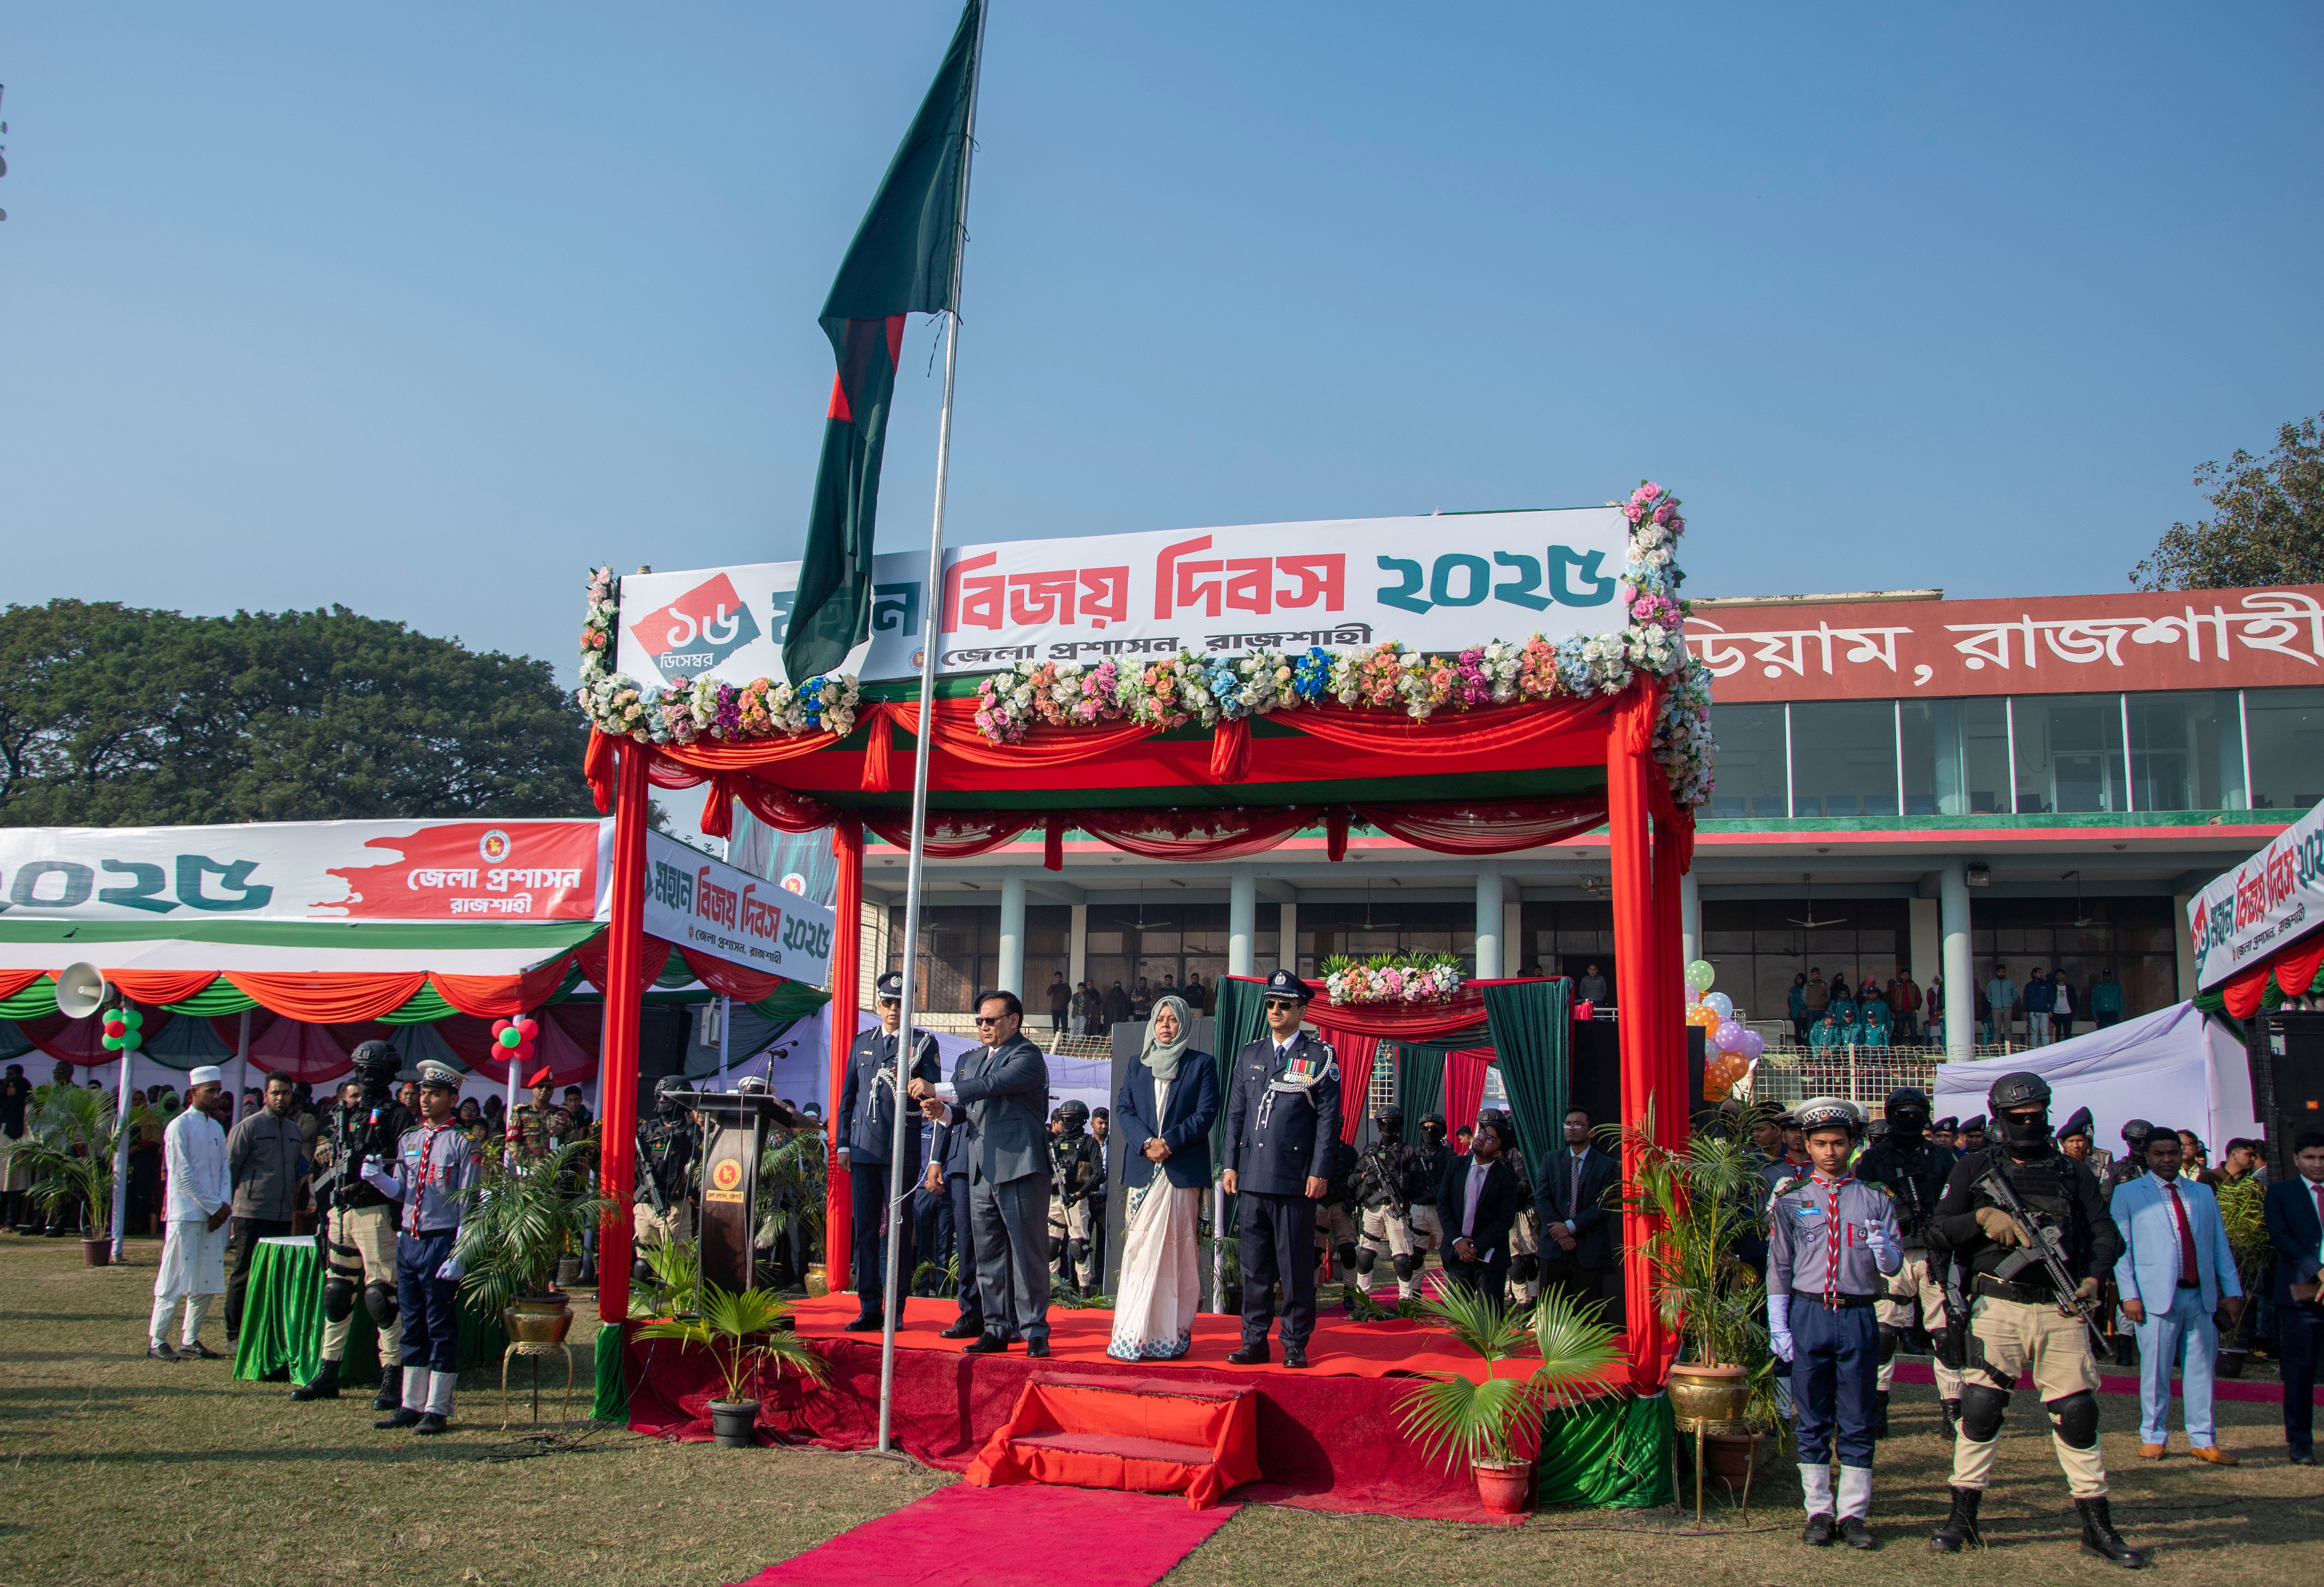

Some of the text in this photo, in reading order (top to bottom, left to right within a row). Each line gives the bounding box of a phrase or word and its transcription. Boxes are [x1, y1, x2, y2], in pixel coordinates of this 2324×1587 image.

[941, 551, 1129, 633] বিজয়
[1155, 534, 1346, 620] দিবস
[1377, 545, 1615, 615] ২০২৫
[667, 603, 739, 648] ১৬
[941, 645, 1037, 666] জেলা
[1204, 623, 1373, 651] রাজশাহী
[1944, 592, 2324, 670] রাজশাহী
[659, 650, 714, 670] ডিসেম্বর
[0, 854, 274, 913] ০২৫
[407, 868, 582, 892] জেলা প্রশাসন
[450, 893, 532, 914] রাজশাহী
[2211, 820, 2324, 949] মহান বিজয় দিবস ২০২
[655, 860, 693, 913] মহান
[696, 865, 738, 932] বিজয়
[740, 883, 781, 943] দিবস
[783, 913, 830, 959] ২০২৫
[2237, 940, 2251, 960] জেলা
[2278, 902, 2305, 936] রাজশাহী
[696, 929, 782, 965] জেলা প্রশাসন, রাজশাহী
